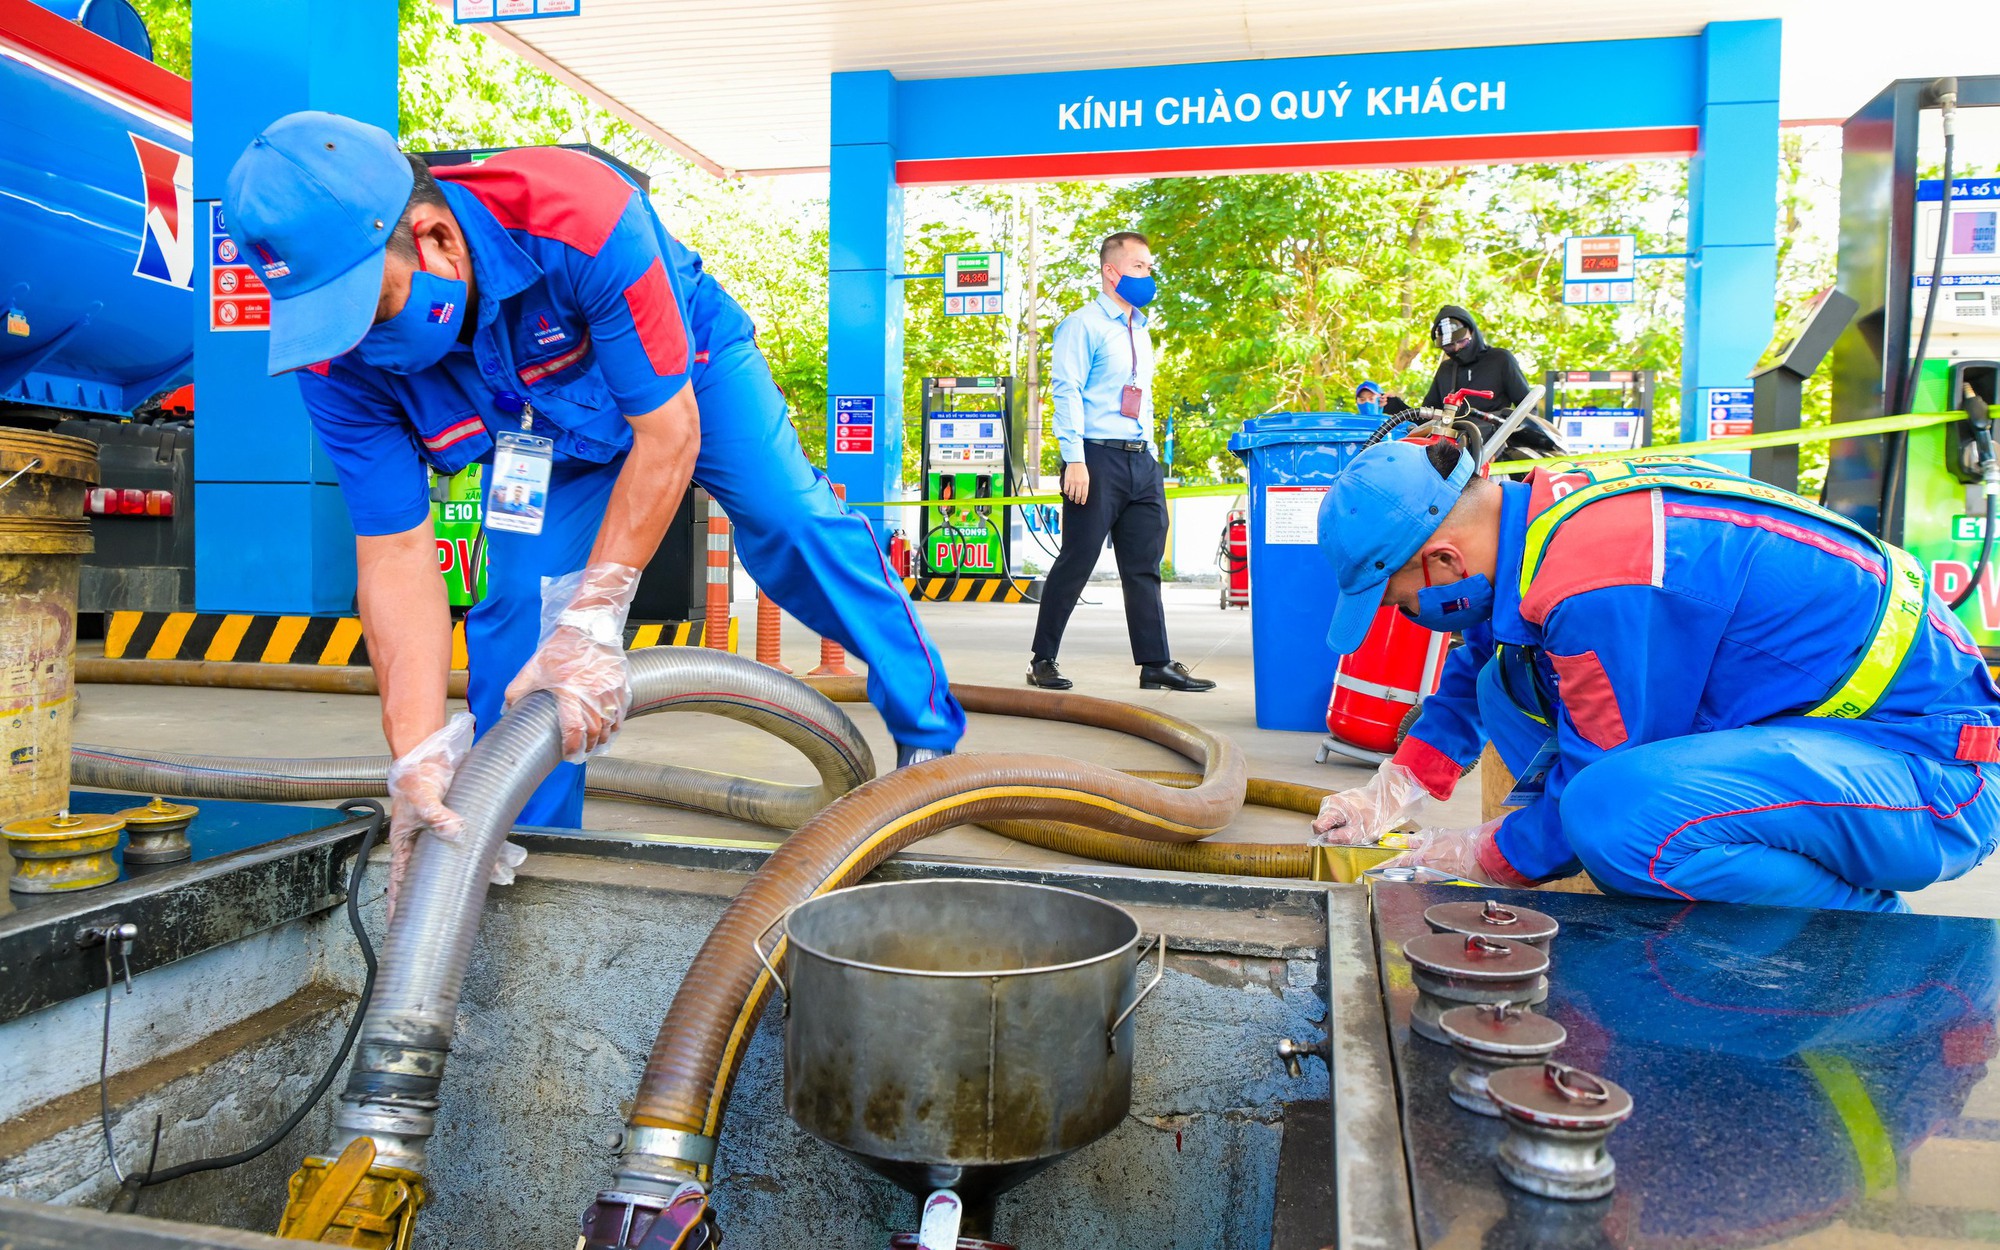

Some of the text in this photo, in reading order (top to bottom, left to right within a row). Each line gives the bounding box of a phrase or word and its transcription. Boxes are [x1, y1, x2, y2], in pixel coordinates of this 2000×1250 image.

[1058, 76, 1507, 130] KÍNH CHÀO QUÝ KHÁCH
[1950, 183, 1969, 197] RẢ
[1971, 181, 1991, 196] SỐ
[445, 503, 473, 520] E10
[936, 542, 994, 568] PVOIL
